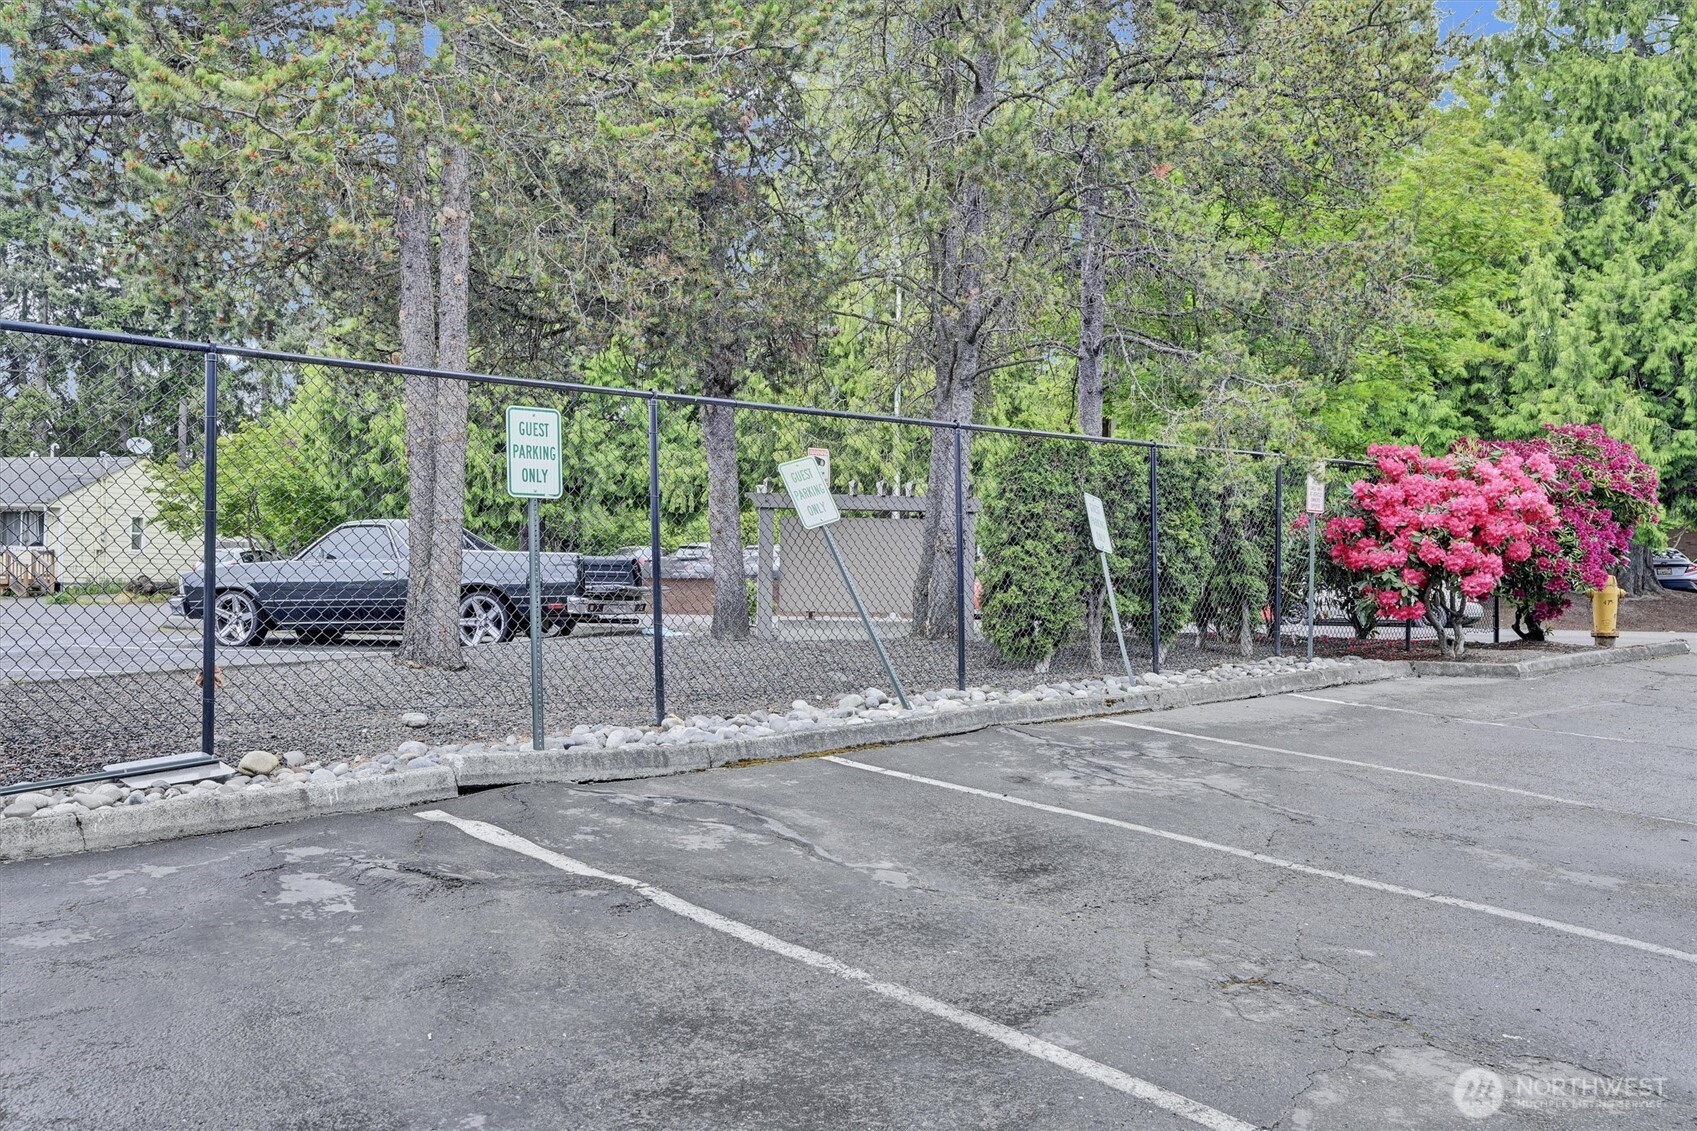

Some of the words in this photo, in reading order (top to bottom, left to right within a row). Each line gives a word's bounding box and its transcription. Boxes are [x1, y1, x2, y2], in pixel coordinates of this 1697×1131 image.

[518, 421, 549, 437] GUEST
[513, 444, 556, 461] PARKING
[521, 467, 548, 483] ONLY
[790, 468, 813, 483] GUEST
[793, 483, 825, 501] PARKING
[806, 501, 827, 516] ONLY
